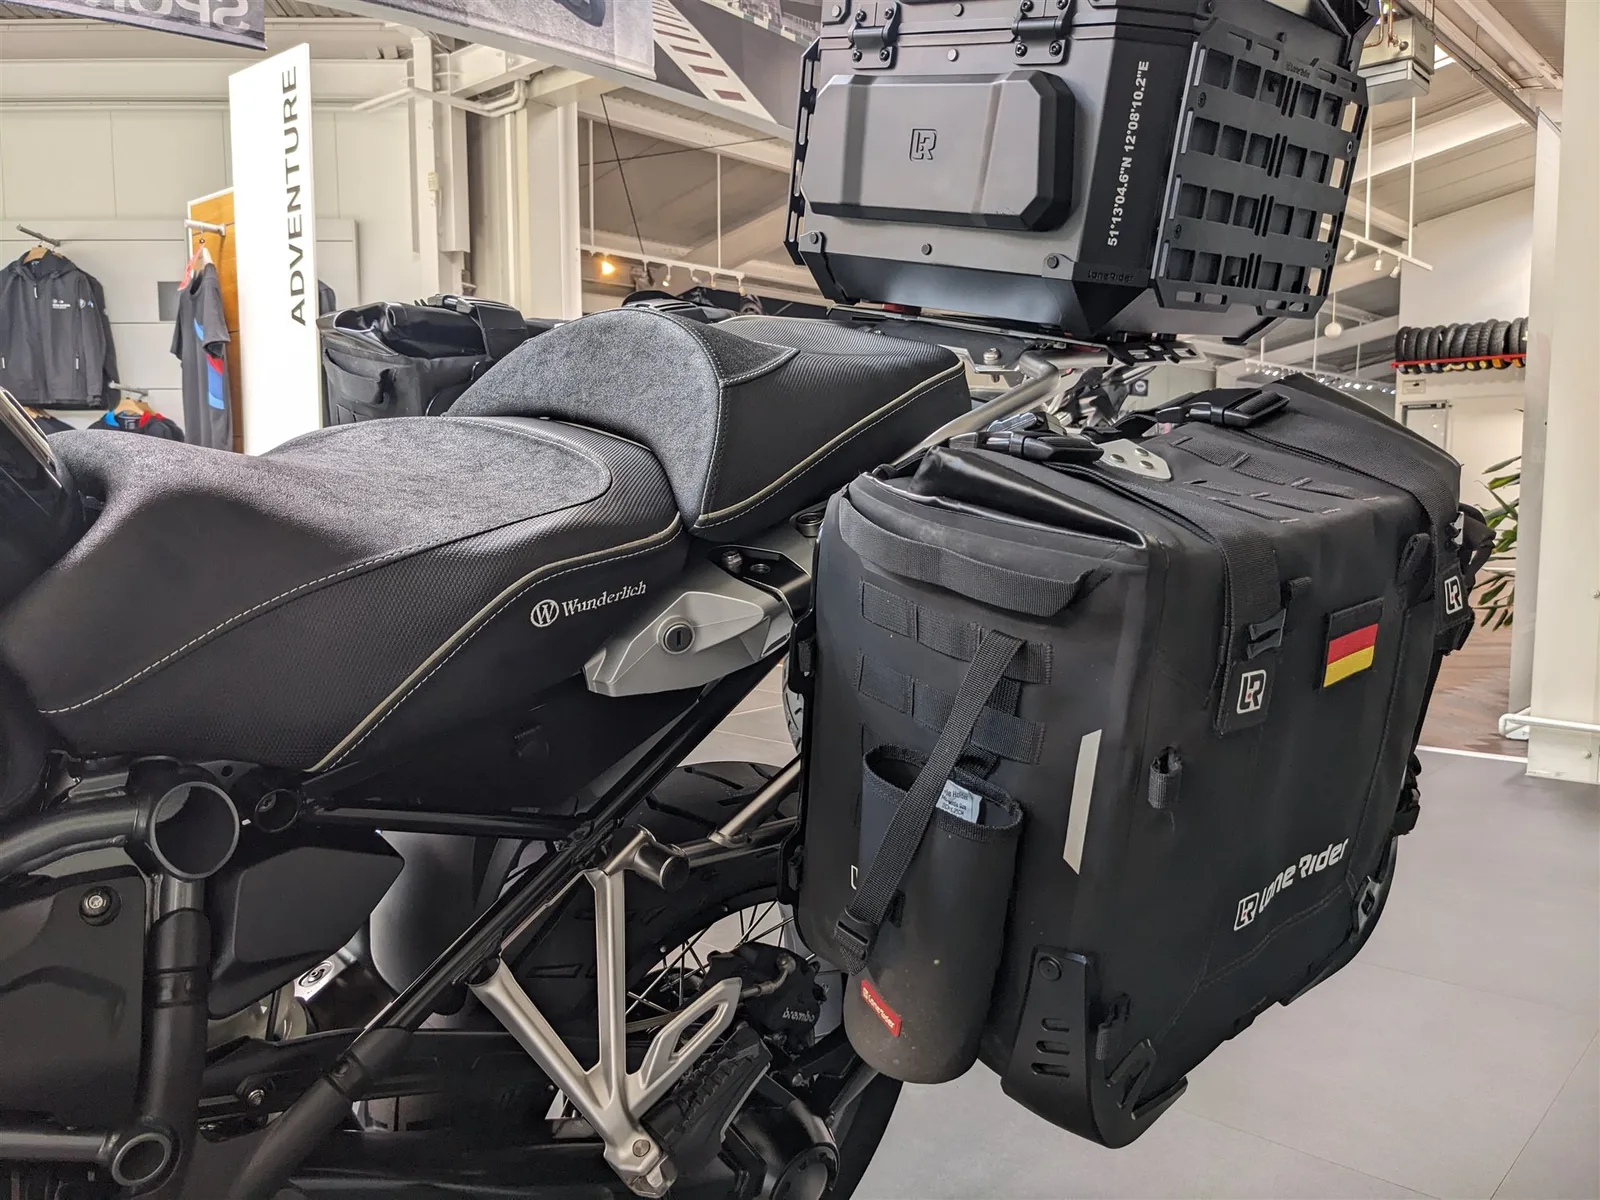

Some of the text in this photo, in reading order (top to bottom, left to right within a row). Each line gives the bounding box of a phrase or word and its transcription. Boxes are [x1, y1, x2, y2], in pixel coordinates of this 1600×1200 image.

[281, 66, 306, 327] ADVENTURE
[561, 580, 647, 617] Wunderlich
[1298, 837, 1350, 879] Rider
[782, 1006, 816, 1023] brembo
